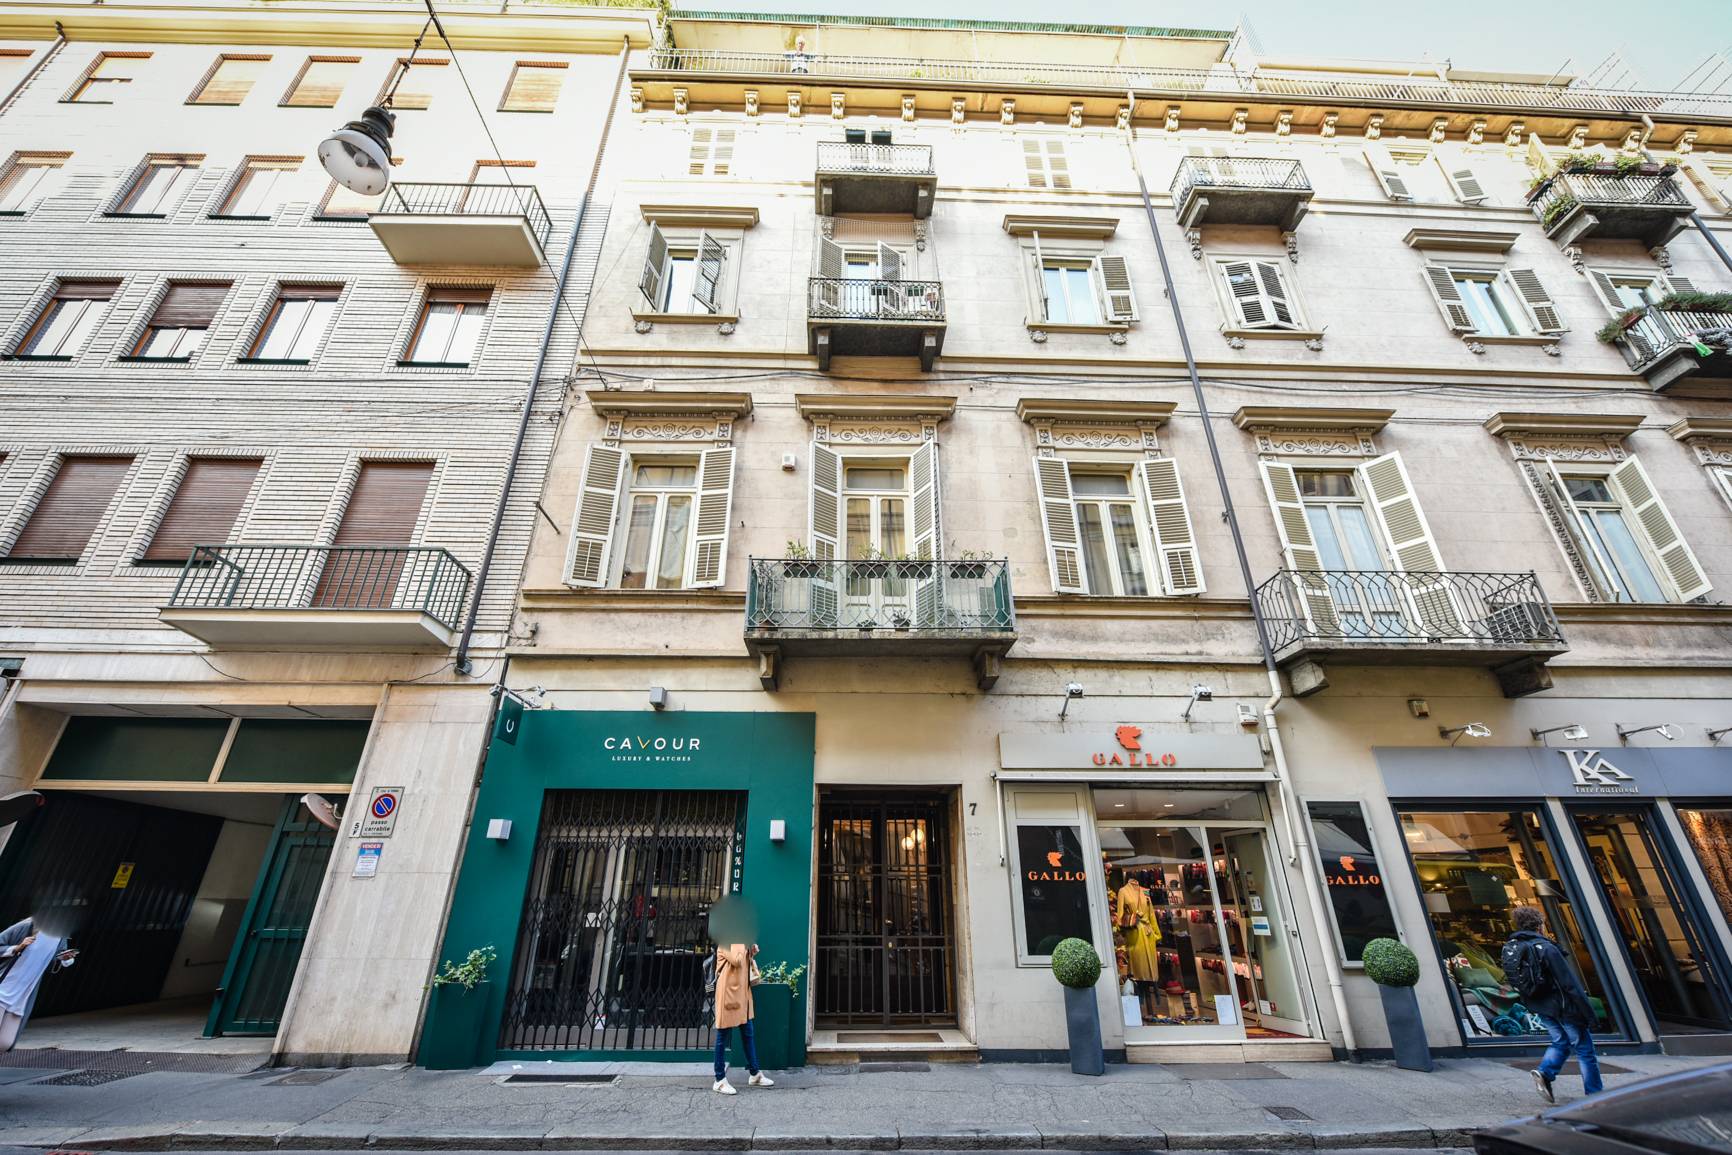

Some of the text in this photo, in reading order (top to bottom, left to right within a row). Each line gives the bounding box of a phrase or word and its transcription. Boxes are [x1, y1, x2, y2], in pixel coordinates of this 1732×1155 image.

[604, 735, 700, 750] CAVOUR
[1092, 751, 1176, 767] GALLO
[1557, 749, 1634, 786] KA
[969, 802, 977, 816] 7
[732, 832, 742, 892] LUXUR
[1028, 871, 1087, 881] GALLO
[1326, 875, 1380, 885] GALLO
